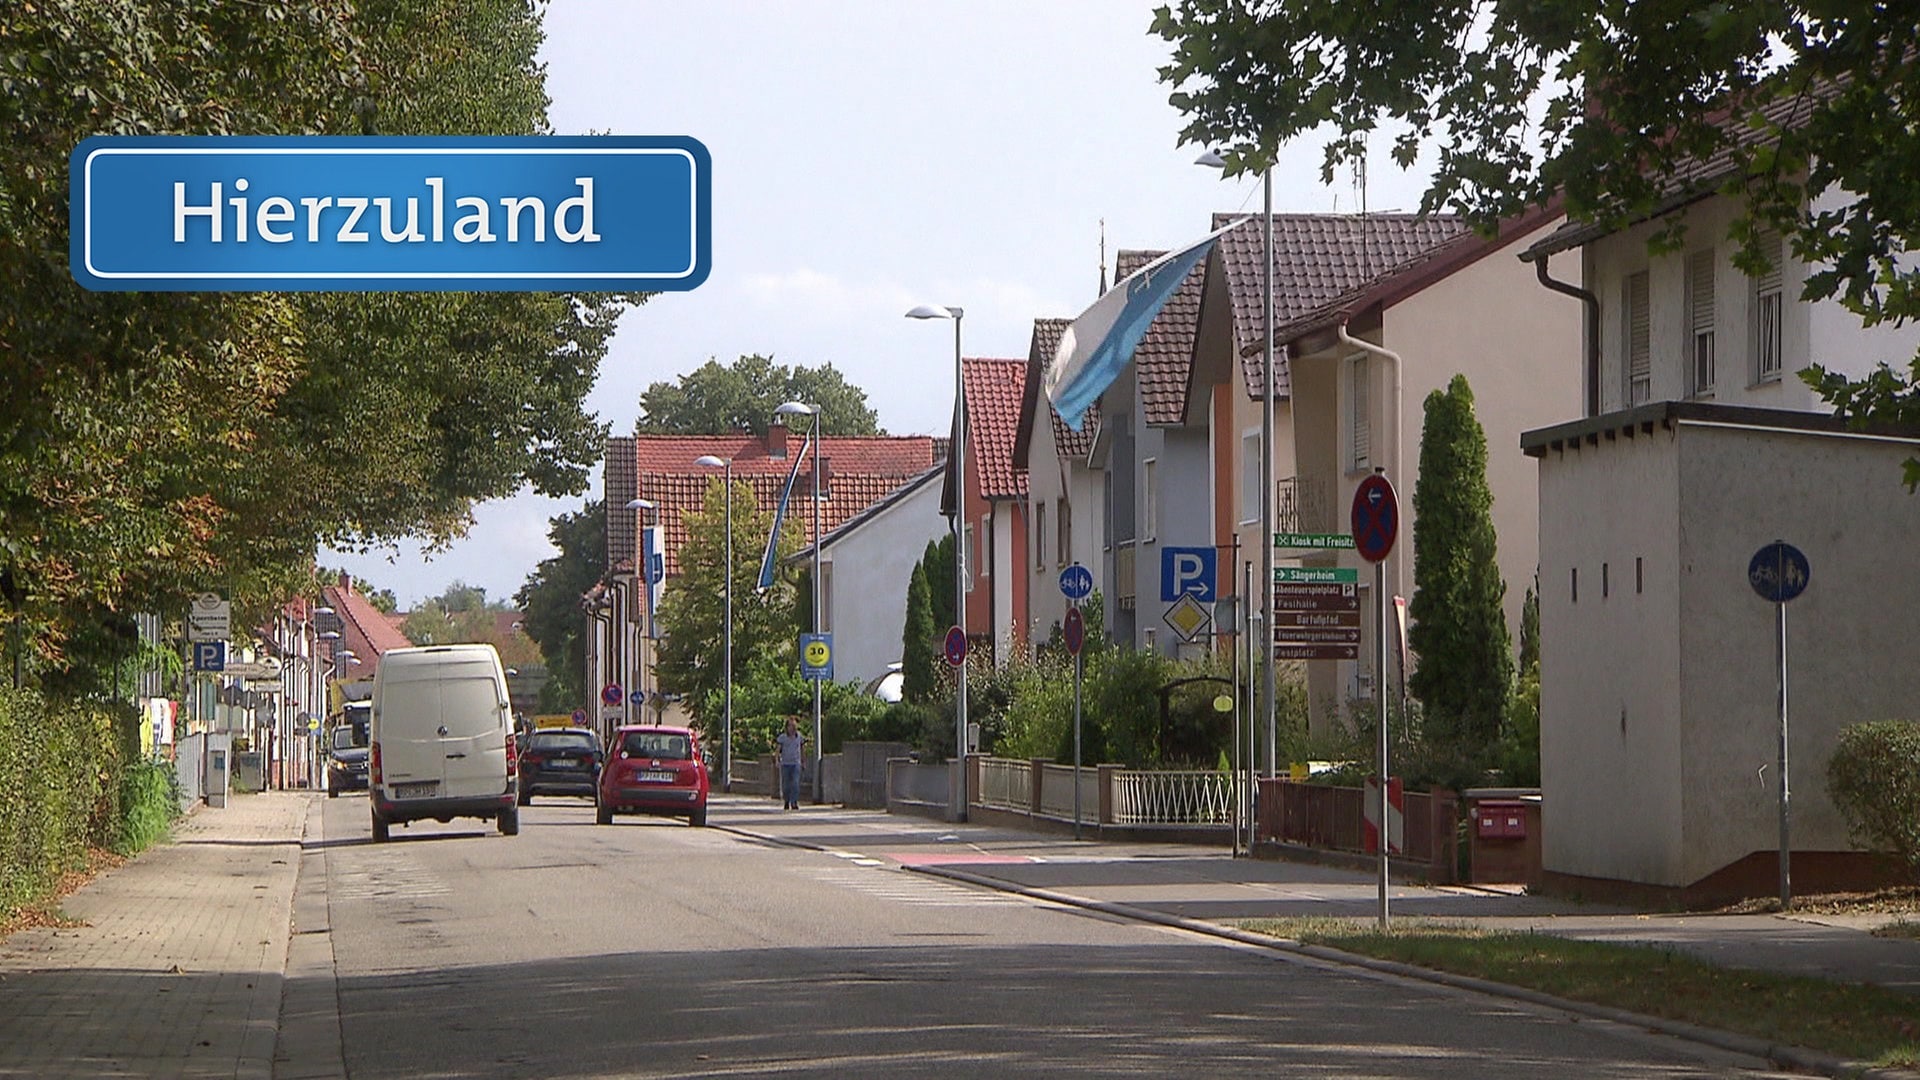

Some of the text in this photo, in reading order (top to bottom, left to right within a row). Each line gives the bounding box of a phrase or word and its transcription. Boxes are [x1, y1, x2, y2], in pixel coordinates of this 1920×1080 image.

[1291, 536, 1353, 547] Kiosk mit Freisitz
[1173, 553, 1204, 596] P
[1290, 570, 1335, 582] Sängerheim
[1276, 585, 1339, 596] Abenteuerspielplatz
[1278, 600, 1318, 609] Festhalle
[201, 645, 217, 669] P
[809, 647, 825, 656] 30
